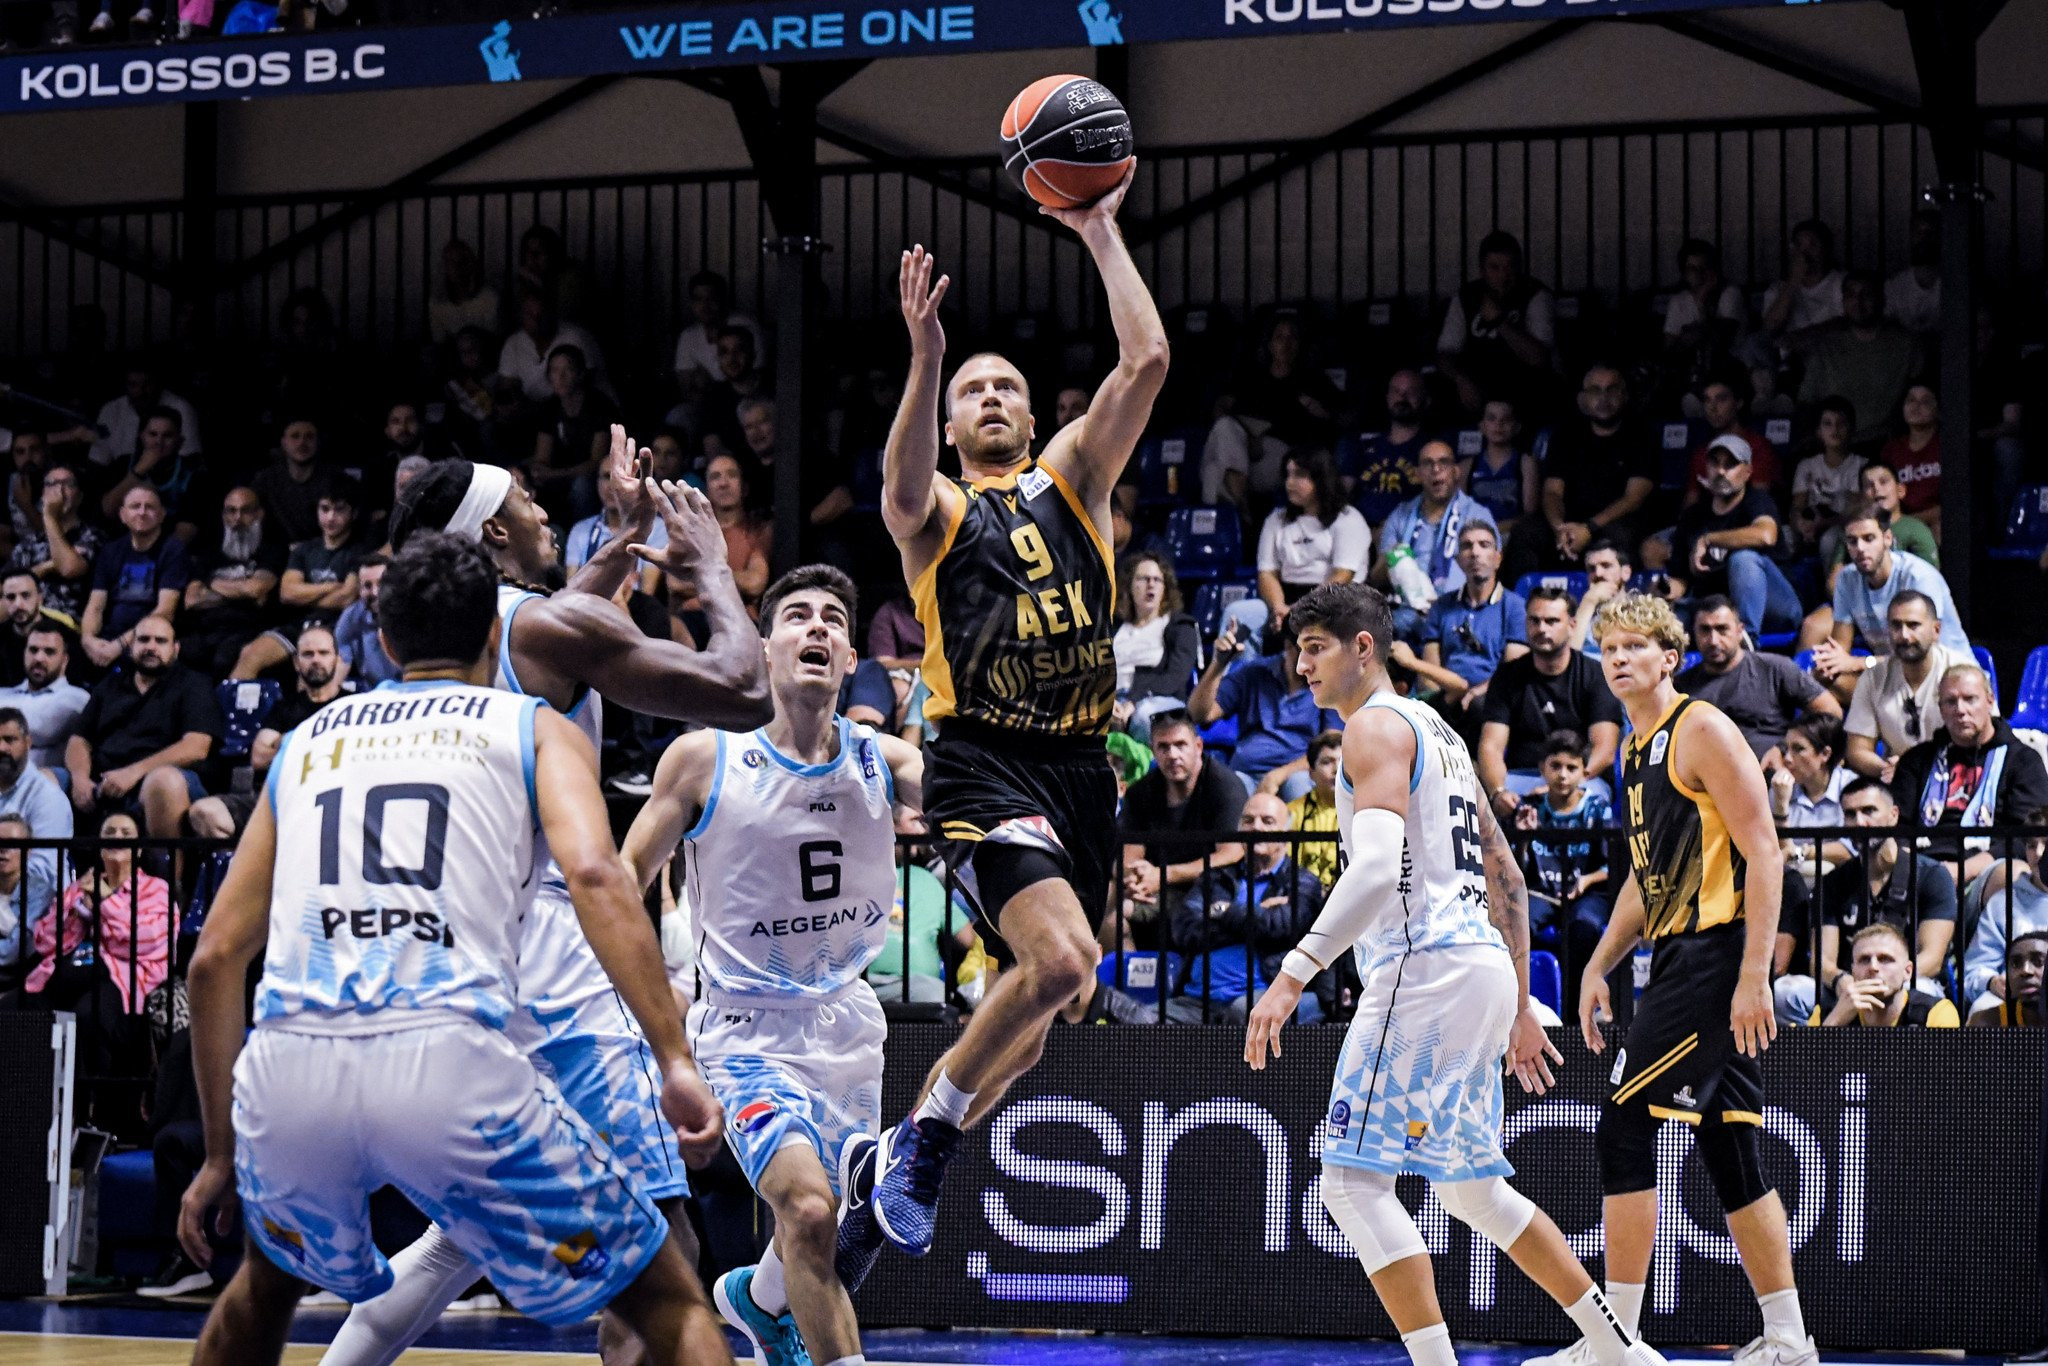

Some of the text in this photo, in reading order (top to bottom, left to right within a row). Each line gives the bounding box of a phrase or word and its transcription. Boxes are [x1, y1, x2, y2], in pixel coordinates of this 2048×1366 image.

[620, 5, 974, 59] WE ARE ONE
[20, 44, 386, 101] KOLOSSOS B.C
[1026, 477, 1050, 497] GBL
[1010, 522, 1053, 582] 9
[1016, 579, 1093, 640] AEK
[311, 695, 491, 739] BARBITCH
[355, 726, 491, 750] HOTELS
[809, 802, 836, 813] FILA
[1627, 782, 1644, 827] 19
[314, 783, 450, 891] 10
[1449, 795, 1485, 877] 25
[799, 840, 844, 902] 6
[750, 907, 858, 937] AEGEAN
